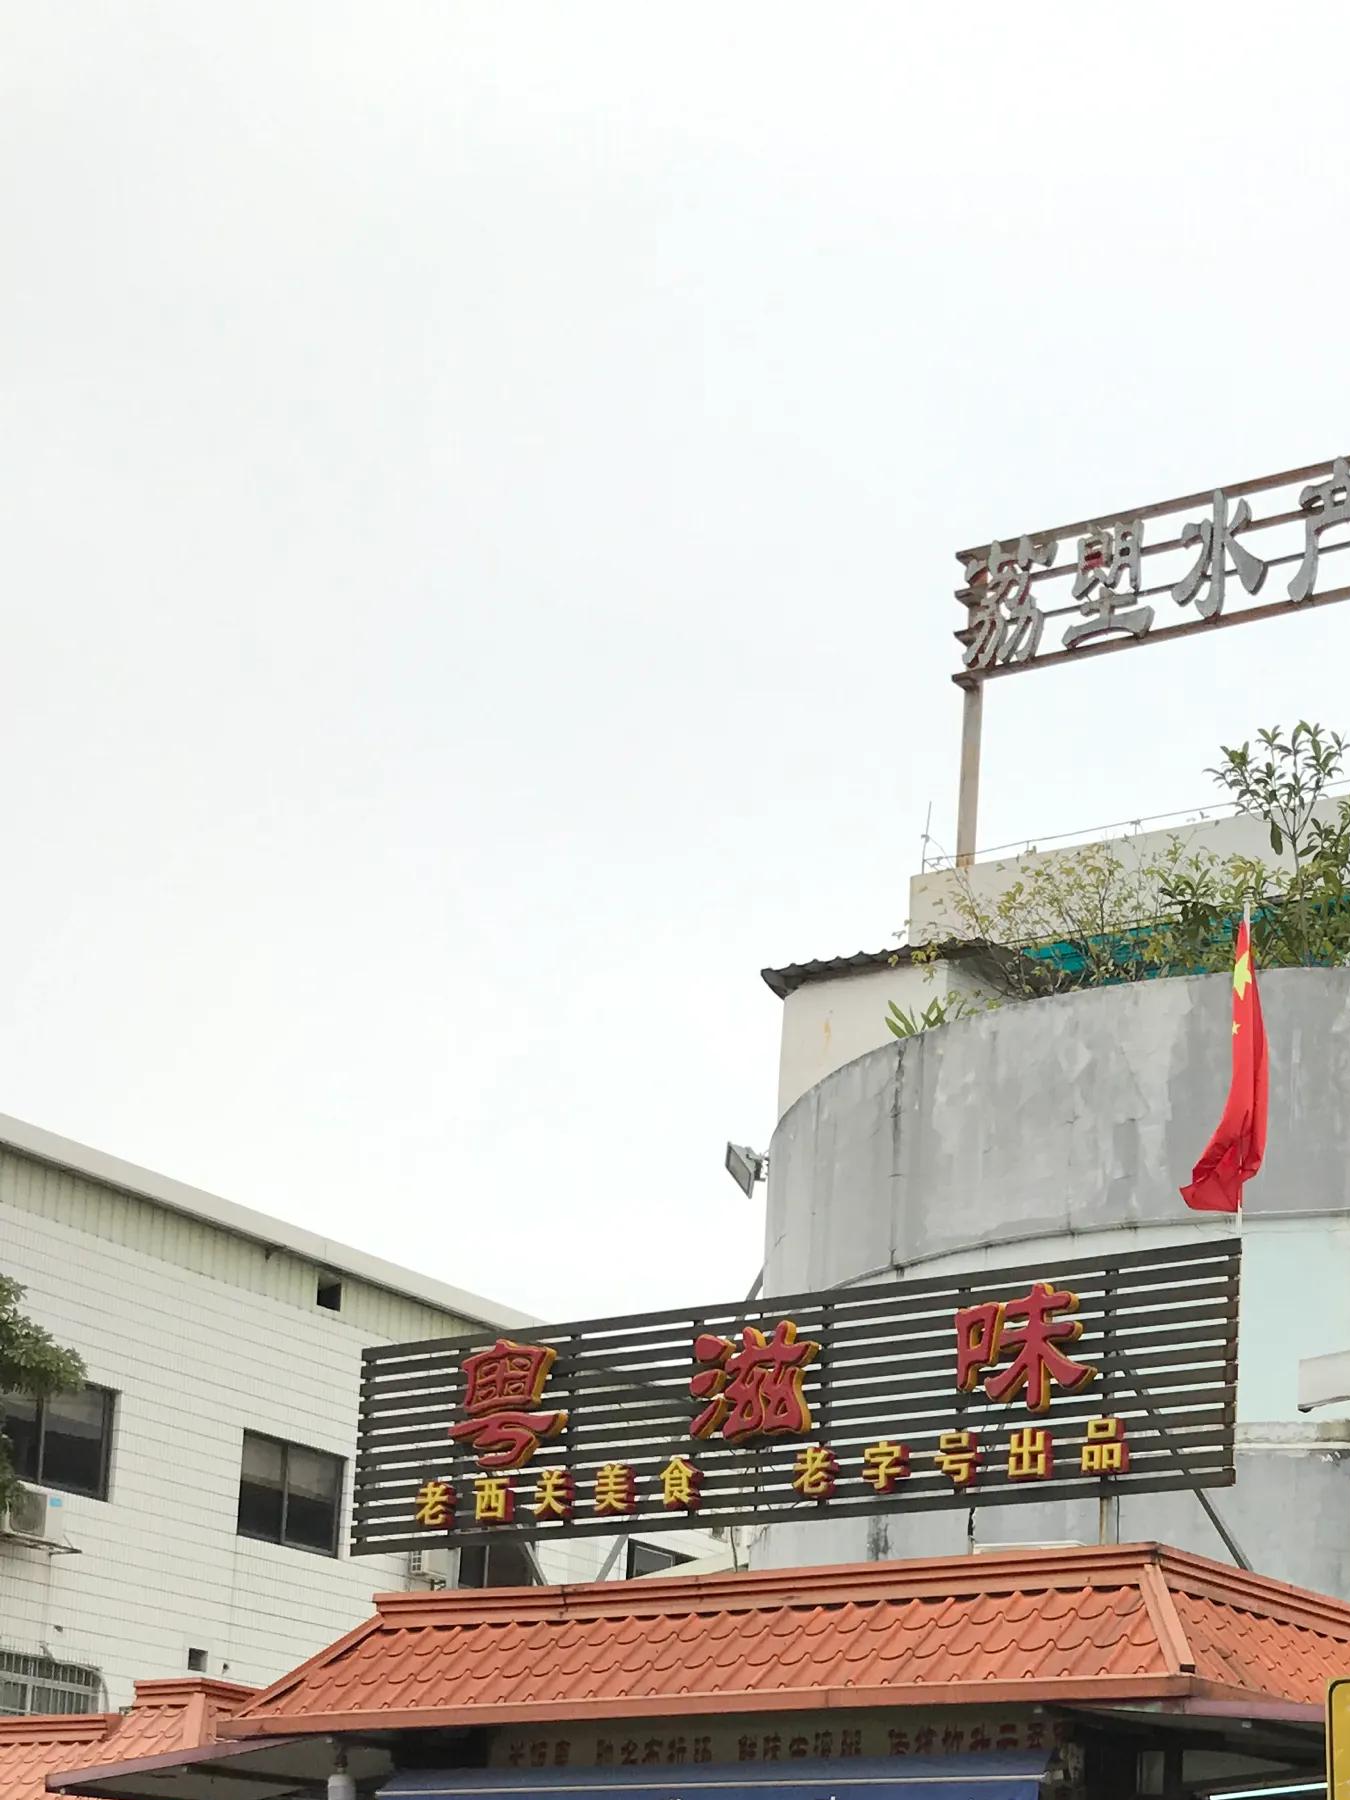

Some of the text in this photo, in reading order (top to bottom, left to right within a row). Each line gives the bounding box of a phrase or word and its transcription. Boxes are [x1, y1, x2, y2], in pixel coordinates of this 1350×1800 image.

[448, 1282, 1098, 1470] 粤滋味
[416, 1417, 1129, 1528] 老西关美食 老字号出品
